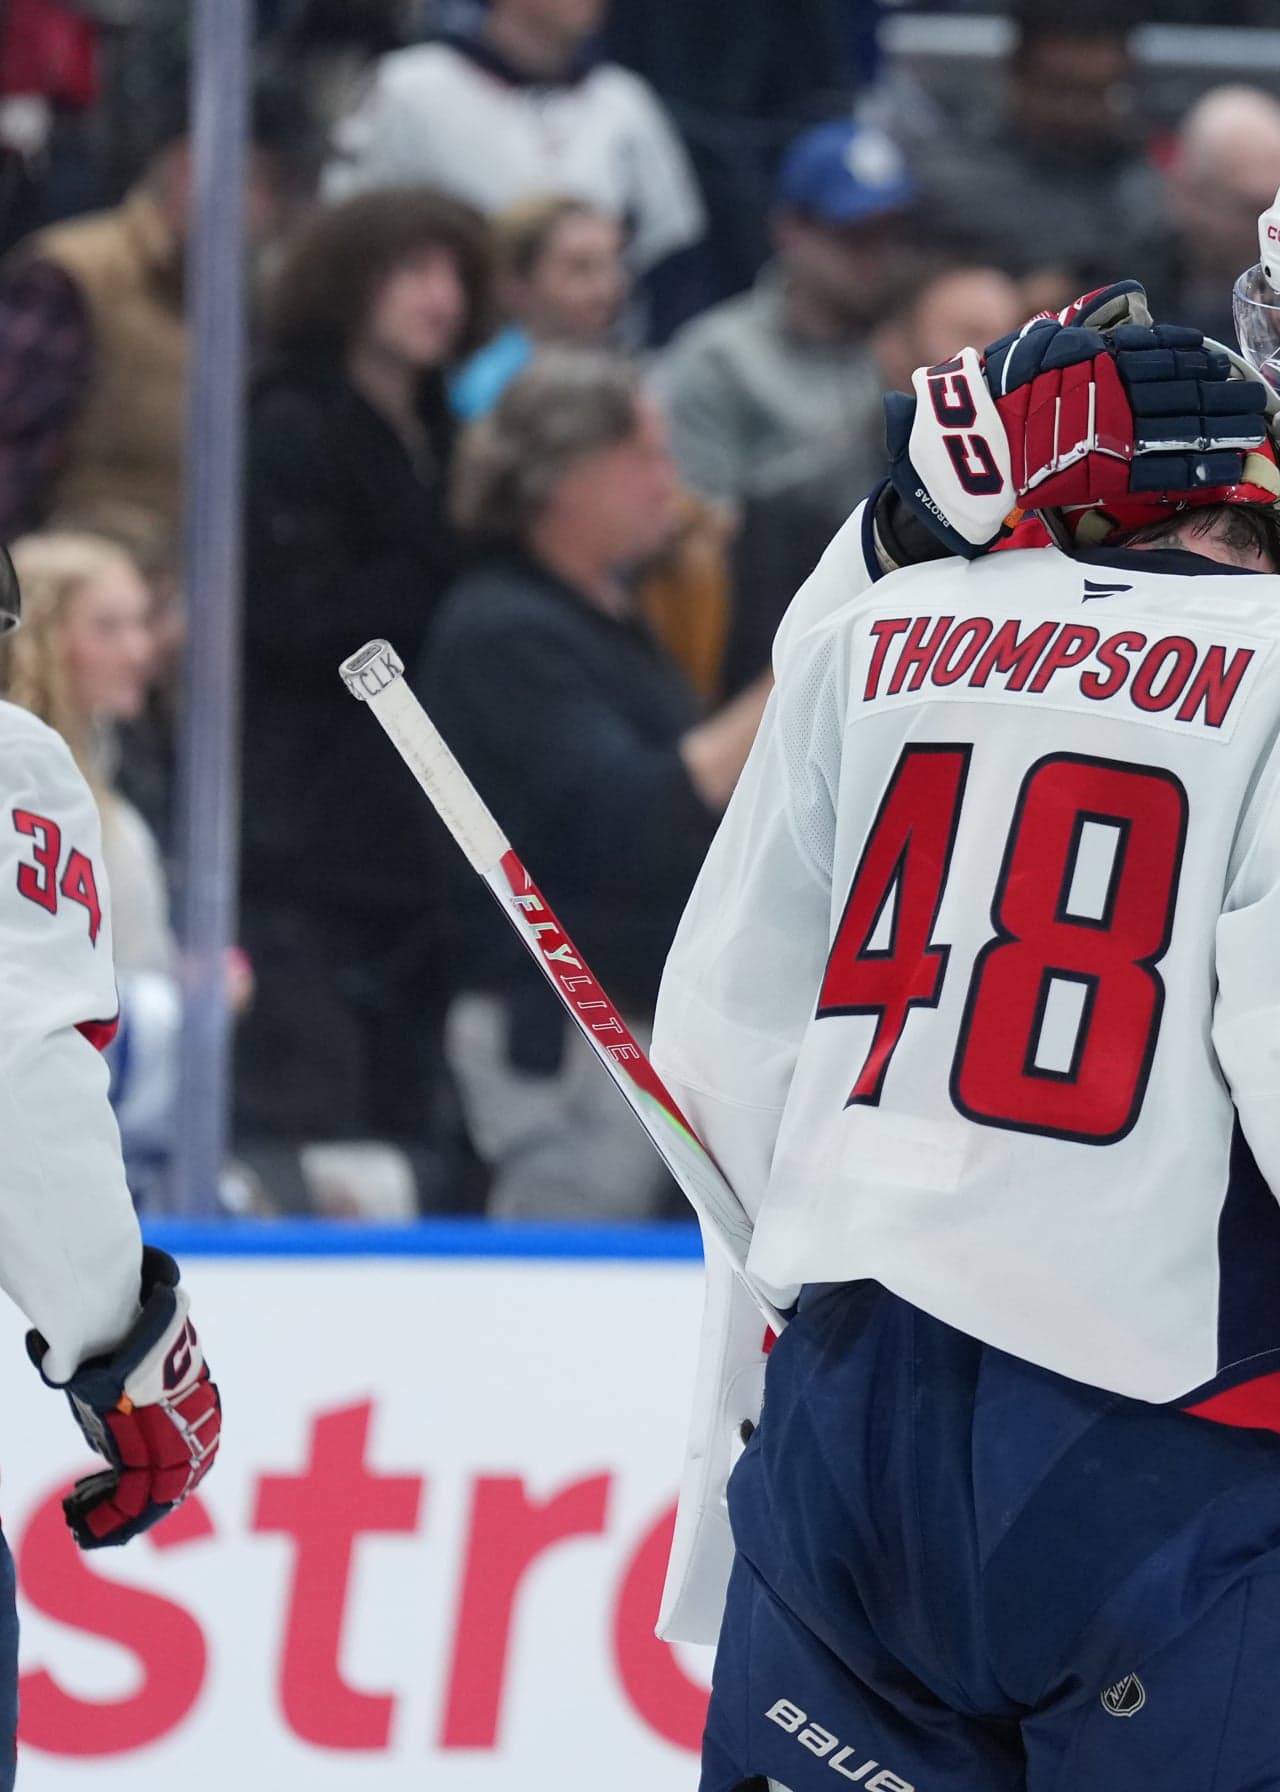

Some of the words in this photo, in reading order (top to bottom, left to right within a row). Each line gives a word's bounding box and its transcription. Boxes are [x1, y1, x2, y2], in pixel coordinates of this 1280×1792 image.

[914, 487, 951, 529] PROTAS
[360, 652, 402, 696] CLK
[862, 615, 1256, 728] THOMPSON
[11, 808, 103, 950] 34
[511, 894, 640, 1062] FLYLITE
[815, 742, 1190, 1147] 48
